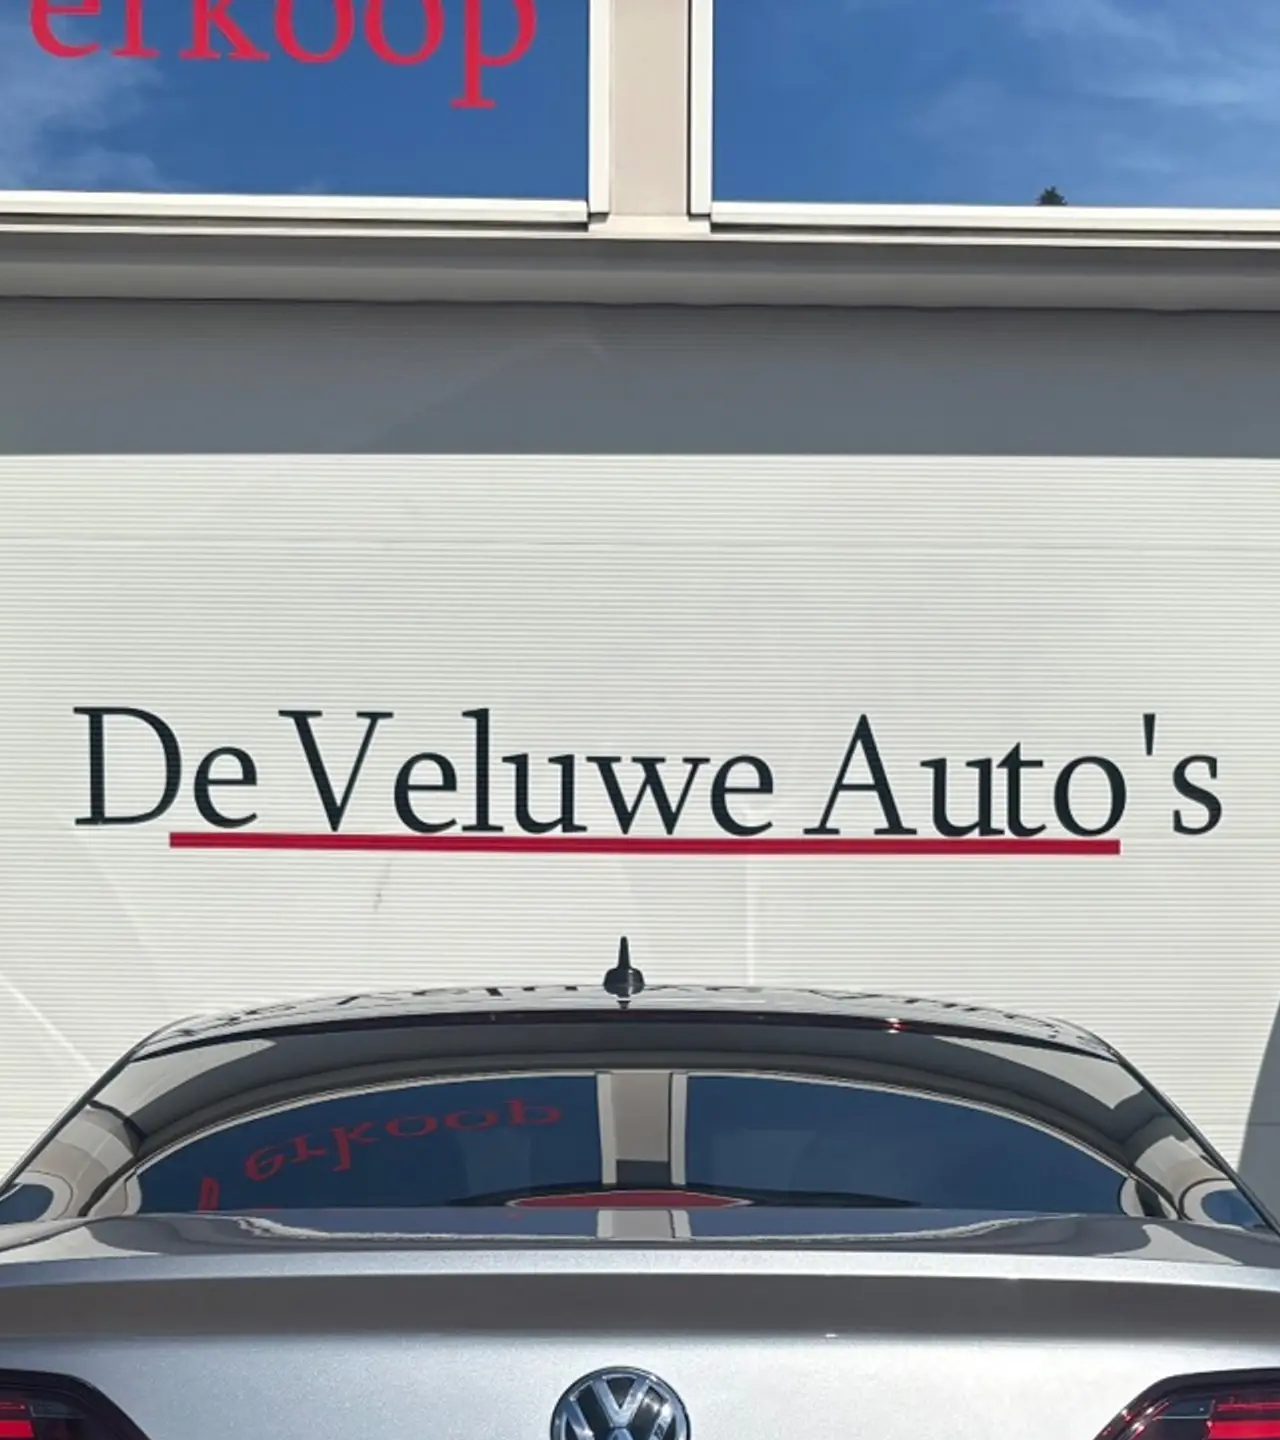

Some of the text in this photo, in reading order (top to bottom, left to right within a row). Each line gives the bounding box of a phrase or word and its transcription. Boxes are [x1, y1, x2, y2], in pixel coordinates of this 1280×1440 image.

[73, 706, 1222, 838] De Veluwe Auto's
